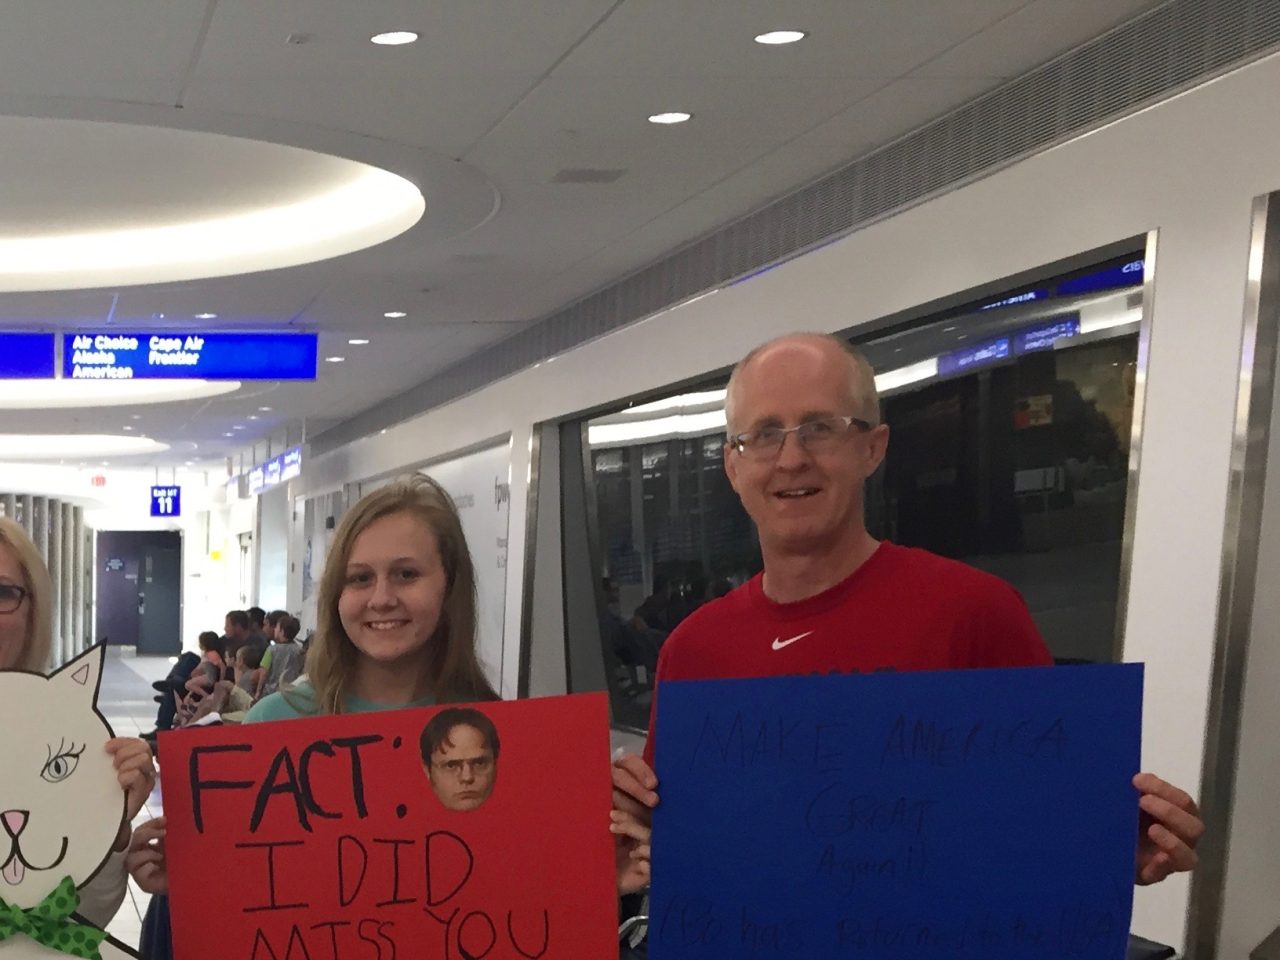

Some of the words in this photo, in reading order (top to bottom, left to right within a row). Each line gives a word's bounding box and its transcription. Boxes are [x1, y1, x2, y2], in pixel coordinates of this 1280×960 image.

[73, 335, 93, 349] Air
[184, 336, 204, 350] Air
[73, 364, 133, 379] American
[158, 496, 173, 514] 11
[880, 714, 1068, 769] AMERICA
[189, 735, 408, 834] FACT:
[235, 840, 309, 913] I
[337, 830, 474, 908] DID
